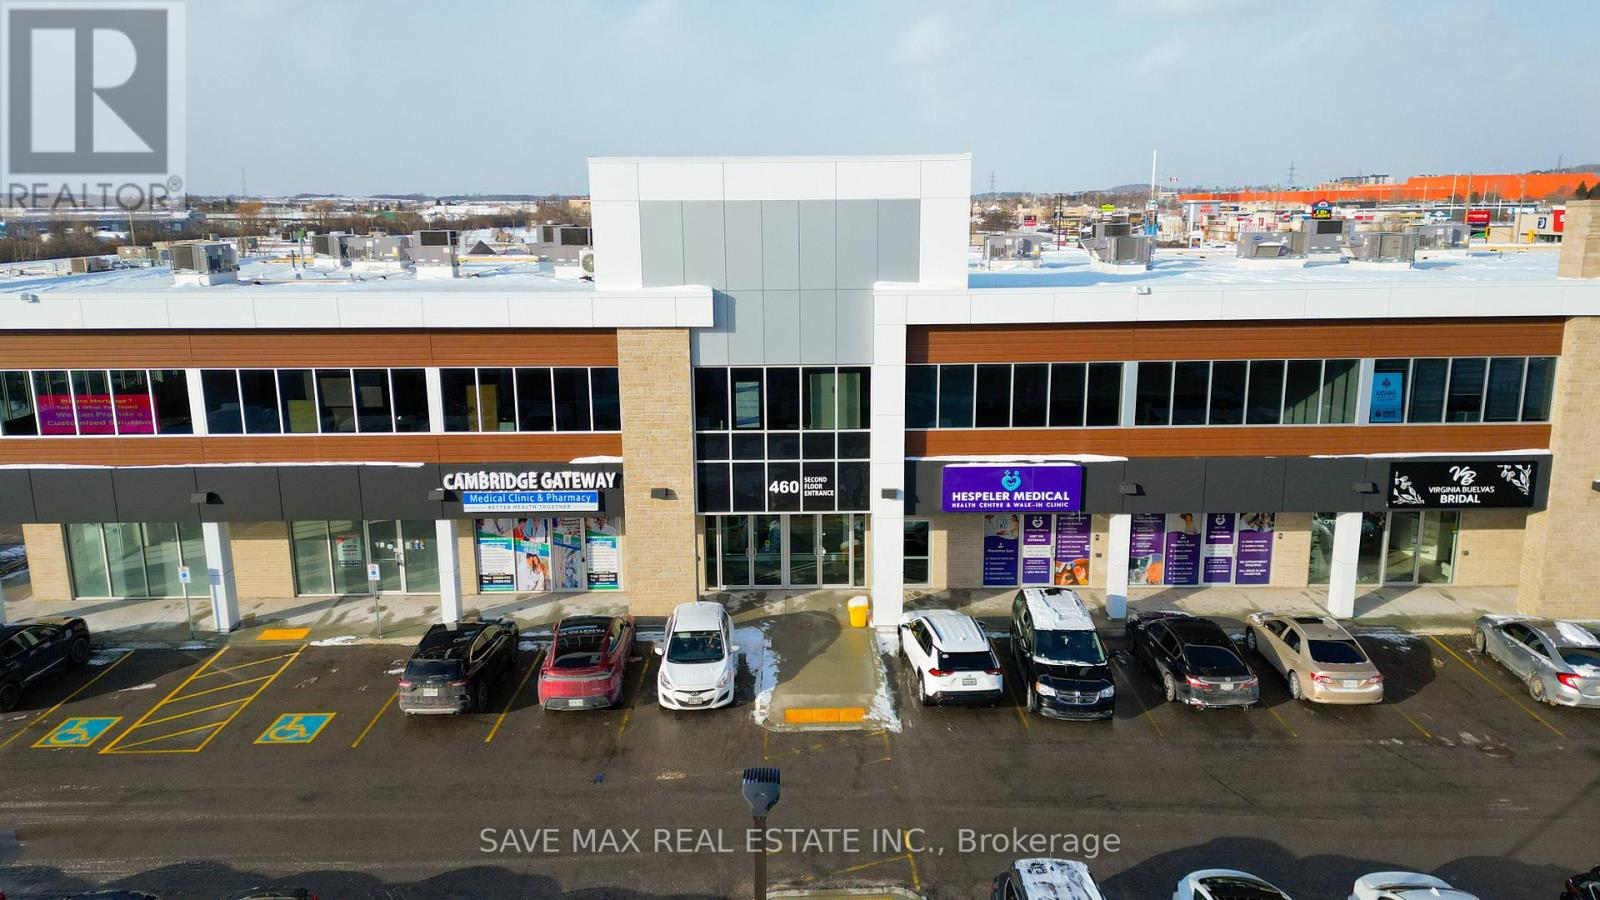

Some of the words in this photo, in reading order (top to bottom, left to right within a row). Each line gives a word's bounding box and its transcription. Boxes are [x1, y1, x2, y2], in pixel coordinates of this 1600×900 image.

[443, 471, 538, 490] CAMBRIDGE
[540, 471, 617, 490] GATEWAY
[769, 481, 800, 493] 460
[1428, 486, 1461, 494] VIRGINIA
[1461, 485, 1496, 494] BUELVAS
[469, 492, 506, 503] Medical
[508, 492, 535, 502] Clinic
[537, 493, 544, 502] &
[546, 491, 592, 504] Pharmacy
[952, 491, 1010, 502] HESPELER
[1013, 491, 1070, 501] MEDICAL
[1439, 494, 1481, 504] BRIDAL
